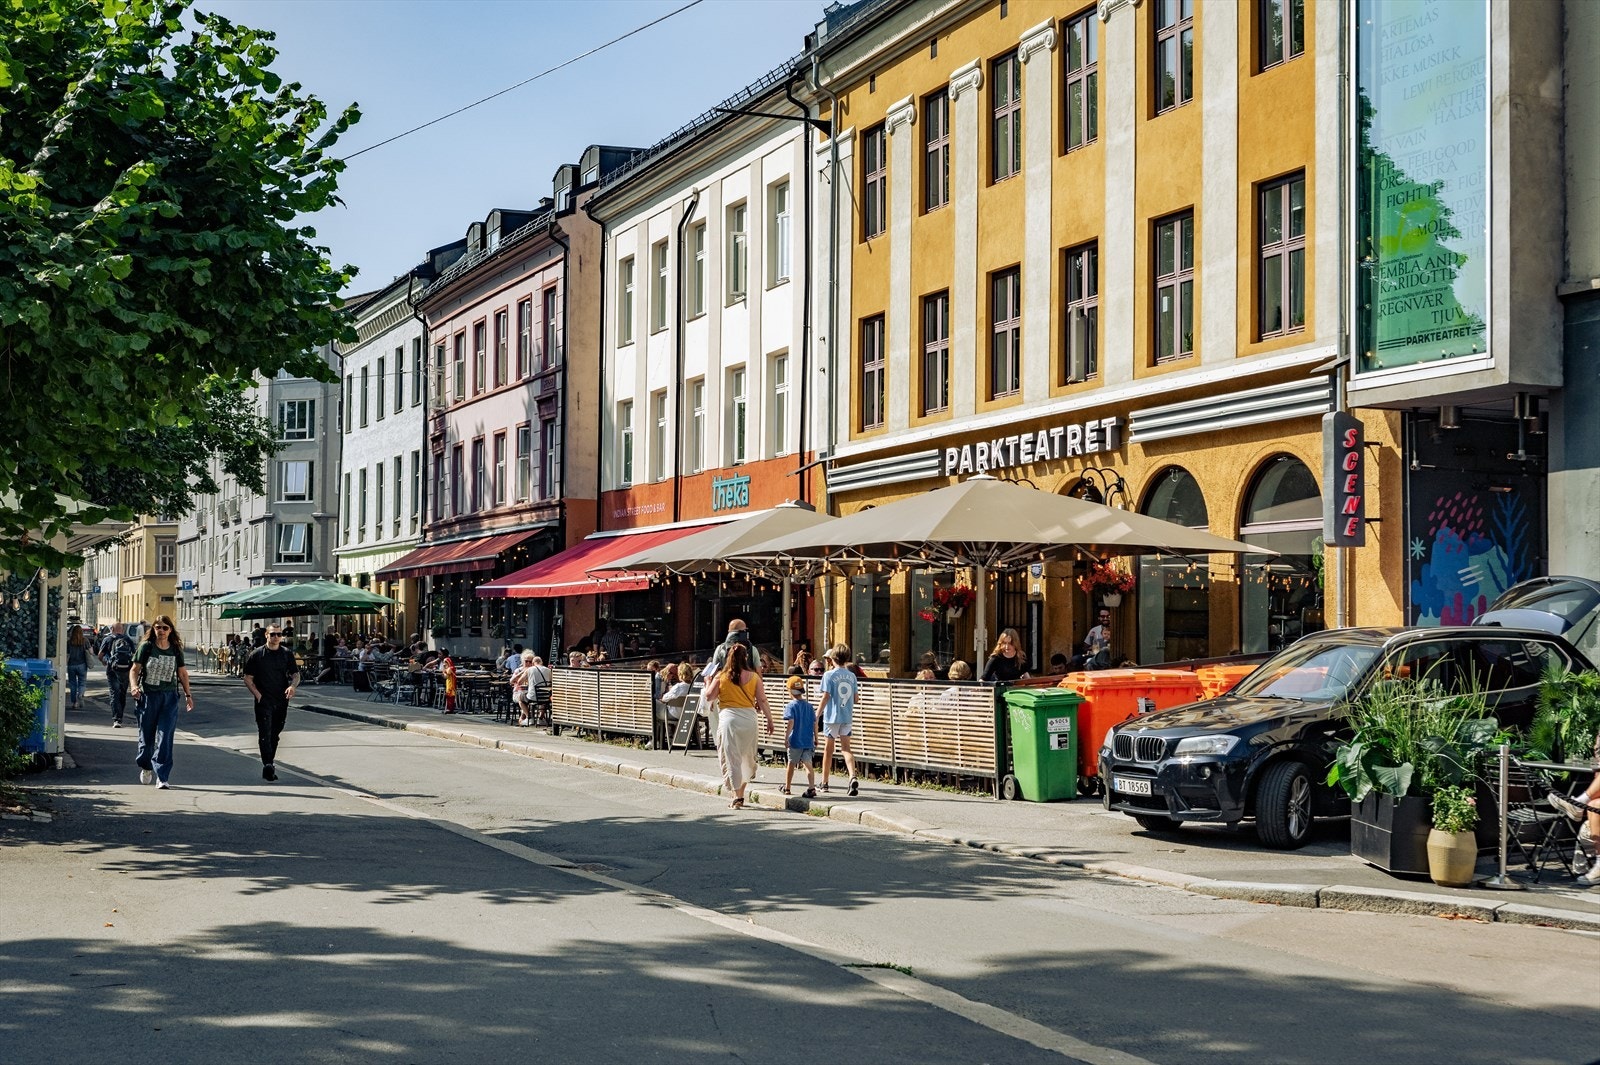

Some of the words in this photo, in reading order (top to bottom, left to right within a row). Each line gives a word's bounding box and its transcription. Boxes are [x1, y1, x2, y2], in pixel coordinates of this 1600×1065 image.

[1381, 7, 1439, 40] ARTEMAS
[1413, 45, 1462, 75] MUSIKK
[1403, 78, 1433, 101] LEWI
[1395, 129, 1427, 149] VAIN
[1407, 138, 1476, 169] FEELGOOD
[1386, 186, 1424, 208] FIGHT
[1380, 260, 1421, 279] EMBLA
[1424, 252, 1459, 271] AND
[1380, 292, 1444, 319] REGNVÆR
[1406, 327, 1471, 345] PARKTEATRET
[946, 417, 1117, 476] PARKTEATRET
[712, 472, 751, 511] theka
[1342, 427, 1361, 538] SCENE
[641, 504, 653, 514] FOOD
[657, 502, 666, 512] BAR
[837, 681, 853, 708] 9
[1119, 779, 1126, 790] BT
[1128, 781, 1149, 793] 18569
